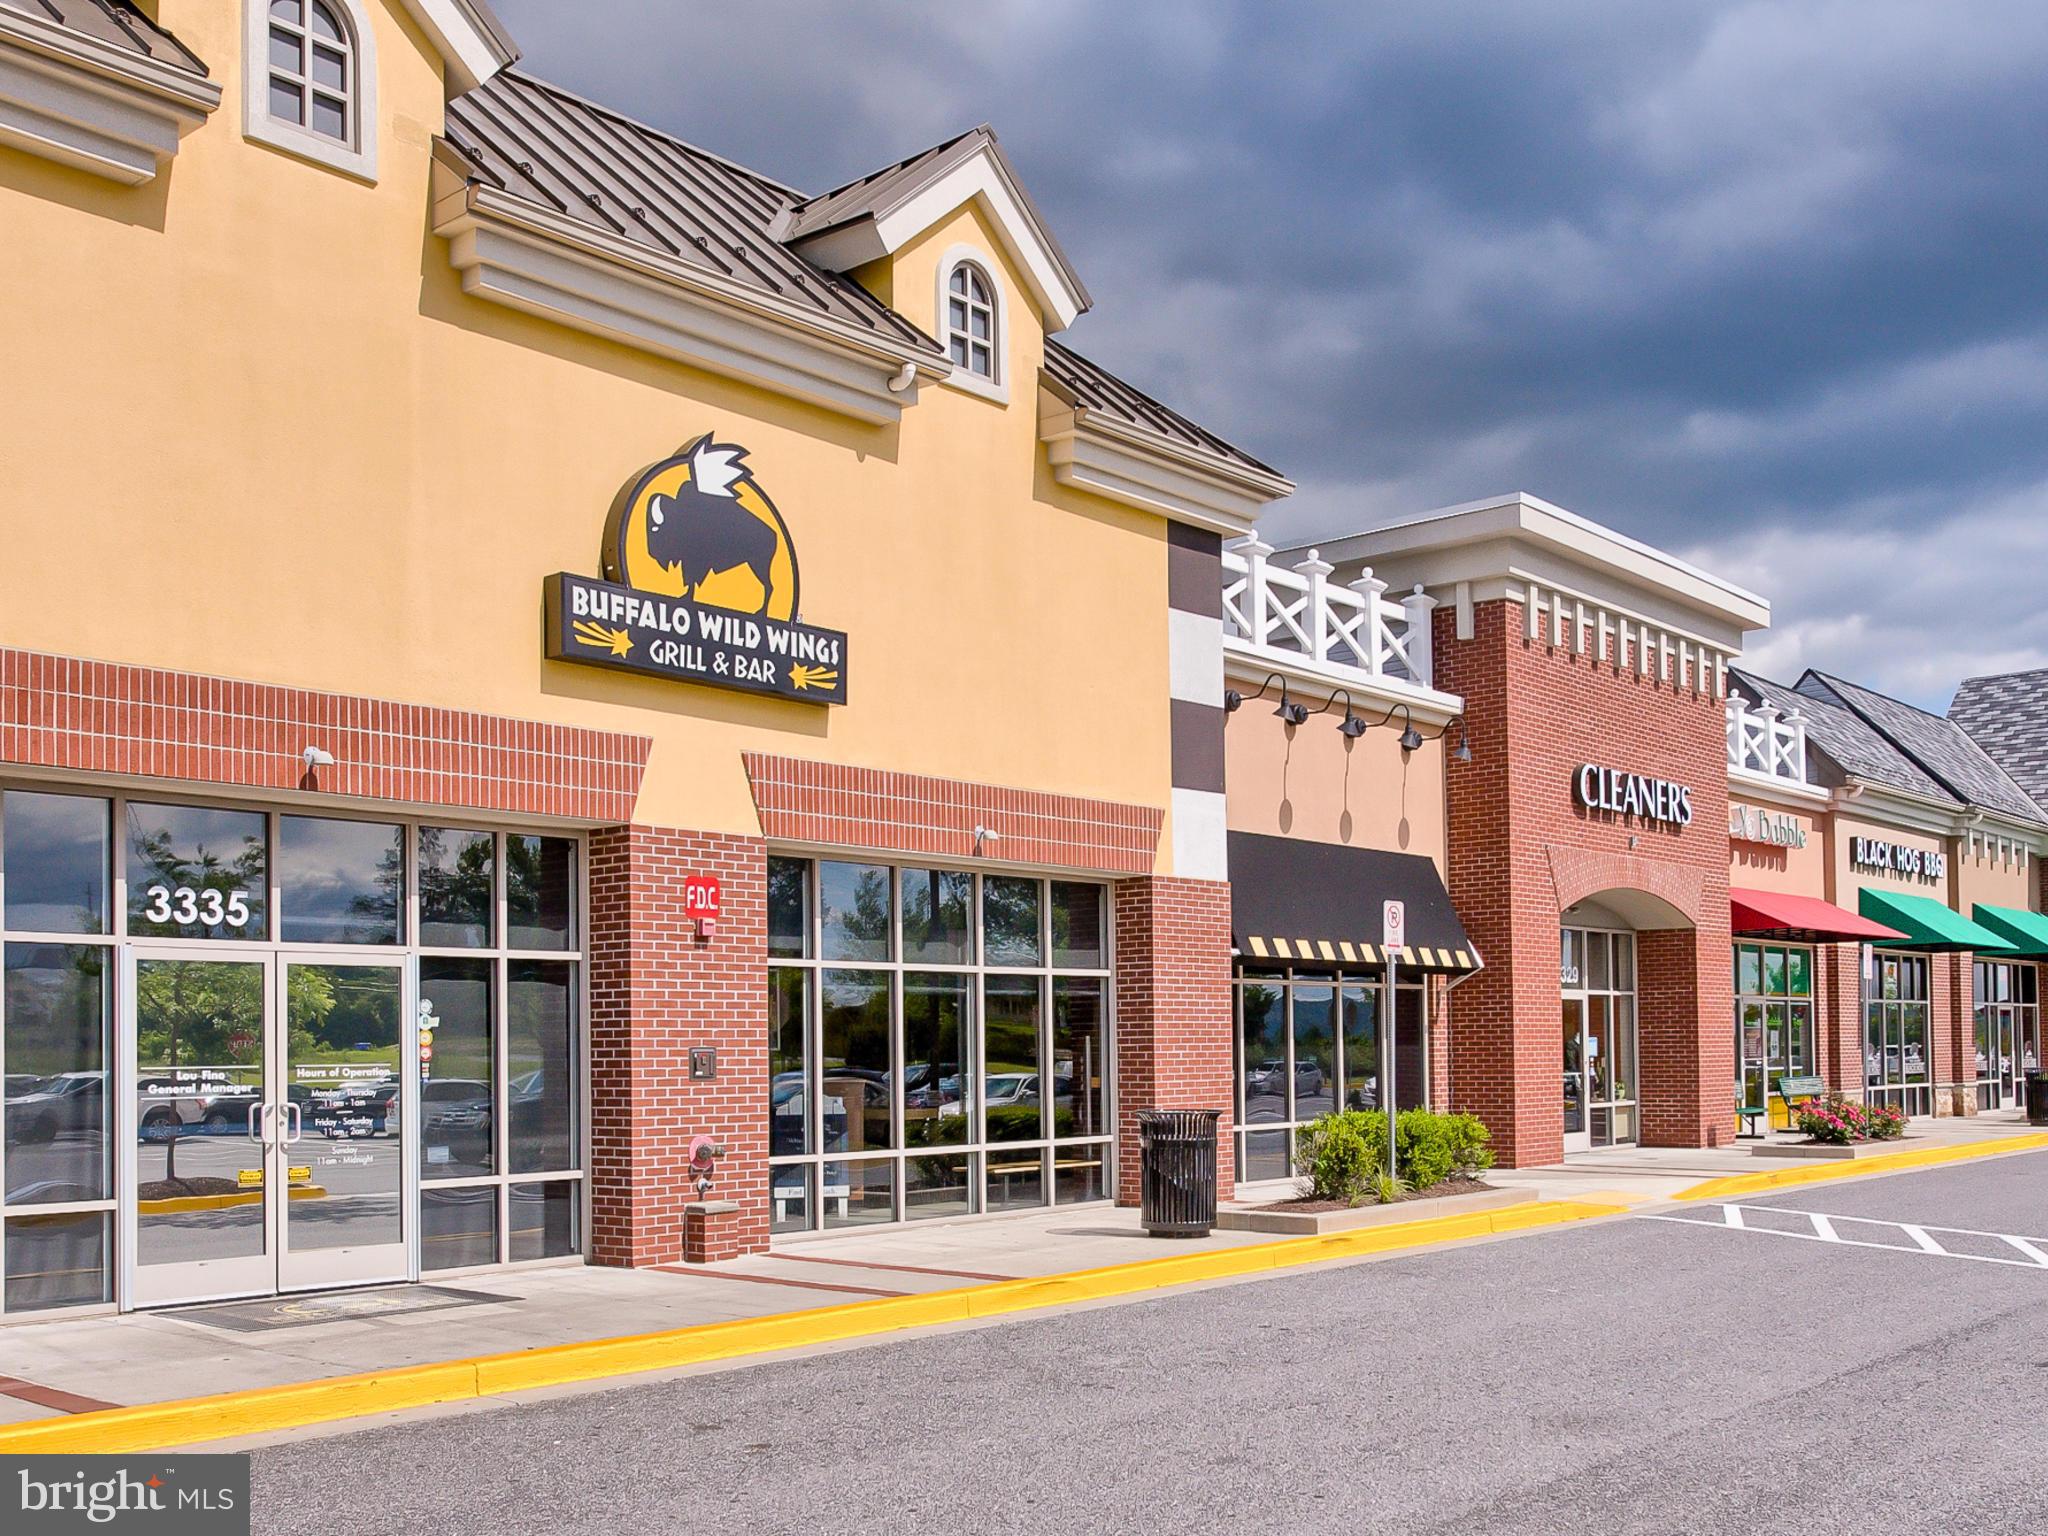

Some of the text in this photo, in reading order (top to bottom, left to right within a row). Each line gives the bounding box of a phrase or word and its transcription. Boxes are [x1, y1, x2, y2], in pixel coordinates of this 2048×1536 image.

[572, 585, 839, 666] BUFFALO WILD WINGS
[649, 639, 776, 684] GRILL & BAR
[1579, 763, 1693, 826] CLEANERS
[1759, 808, 1807, 848] Bubble
[1857, 836, 1944, 878] BLACK HOG BBQ
[146, 884, 249, 927] 3335
[176, 1071, 198, 1080] Lou
[296, 1067, 391, 1079] Hours of Operation
[148, 1083, 254, 1095] General Manager
[311, 1090, 341, 1099] Monday
[347, 1089, 377, 1098] Thursday
[324, 1099, 345, 1107] 11am
[351, 1098, 366, 1106] 1am
[314, 1118, 338, 1128] Friday
[342, 1117, 374, 1127] Saturday
[323, 1128, 345, 1136] 11am
[350, 1127, 366, 1135] 2am
[331, 1146, 358, 1155] Sunday
[317, 1157, 338, 1165] 11am
[343, 1155, 374, 1165] Midnight
